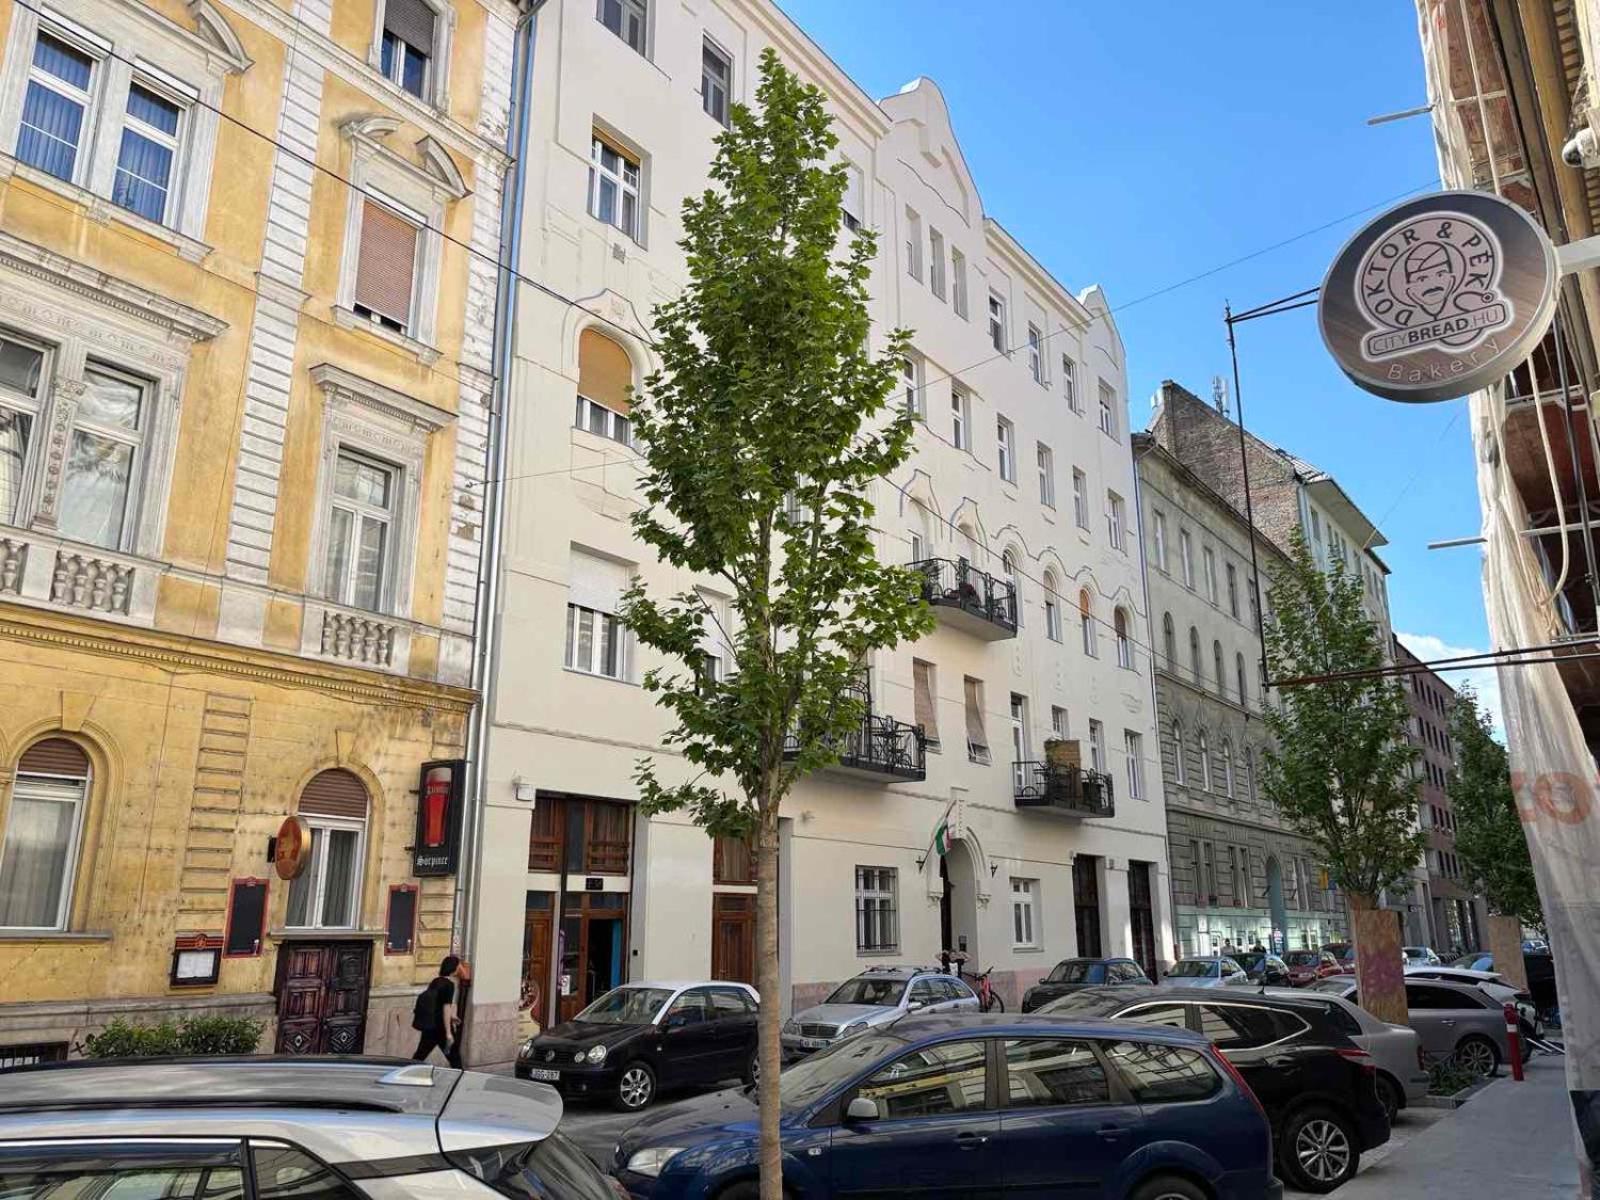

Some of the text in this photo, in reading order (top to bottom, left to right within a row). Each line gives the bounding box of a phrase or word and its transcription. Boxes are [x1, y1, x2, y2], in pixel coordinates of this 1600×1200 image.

[1365, 228, 1420, 326] DOKTOR
[1436, 221, 1453, 239] &
[1387, 338, 1501, 382] Bakery
